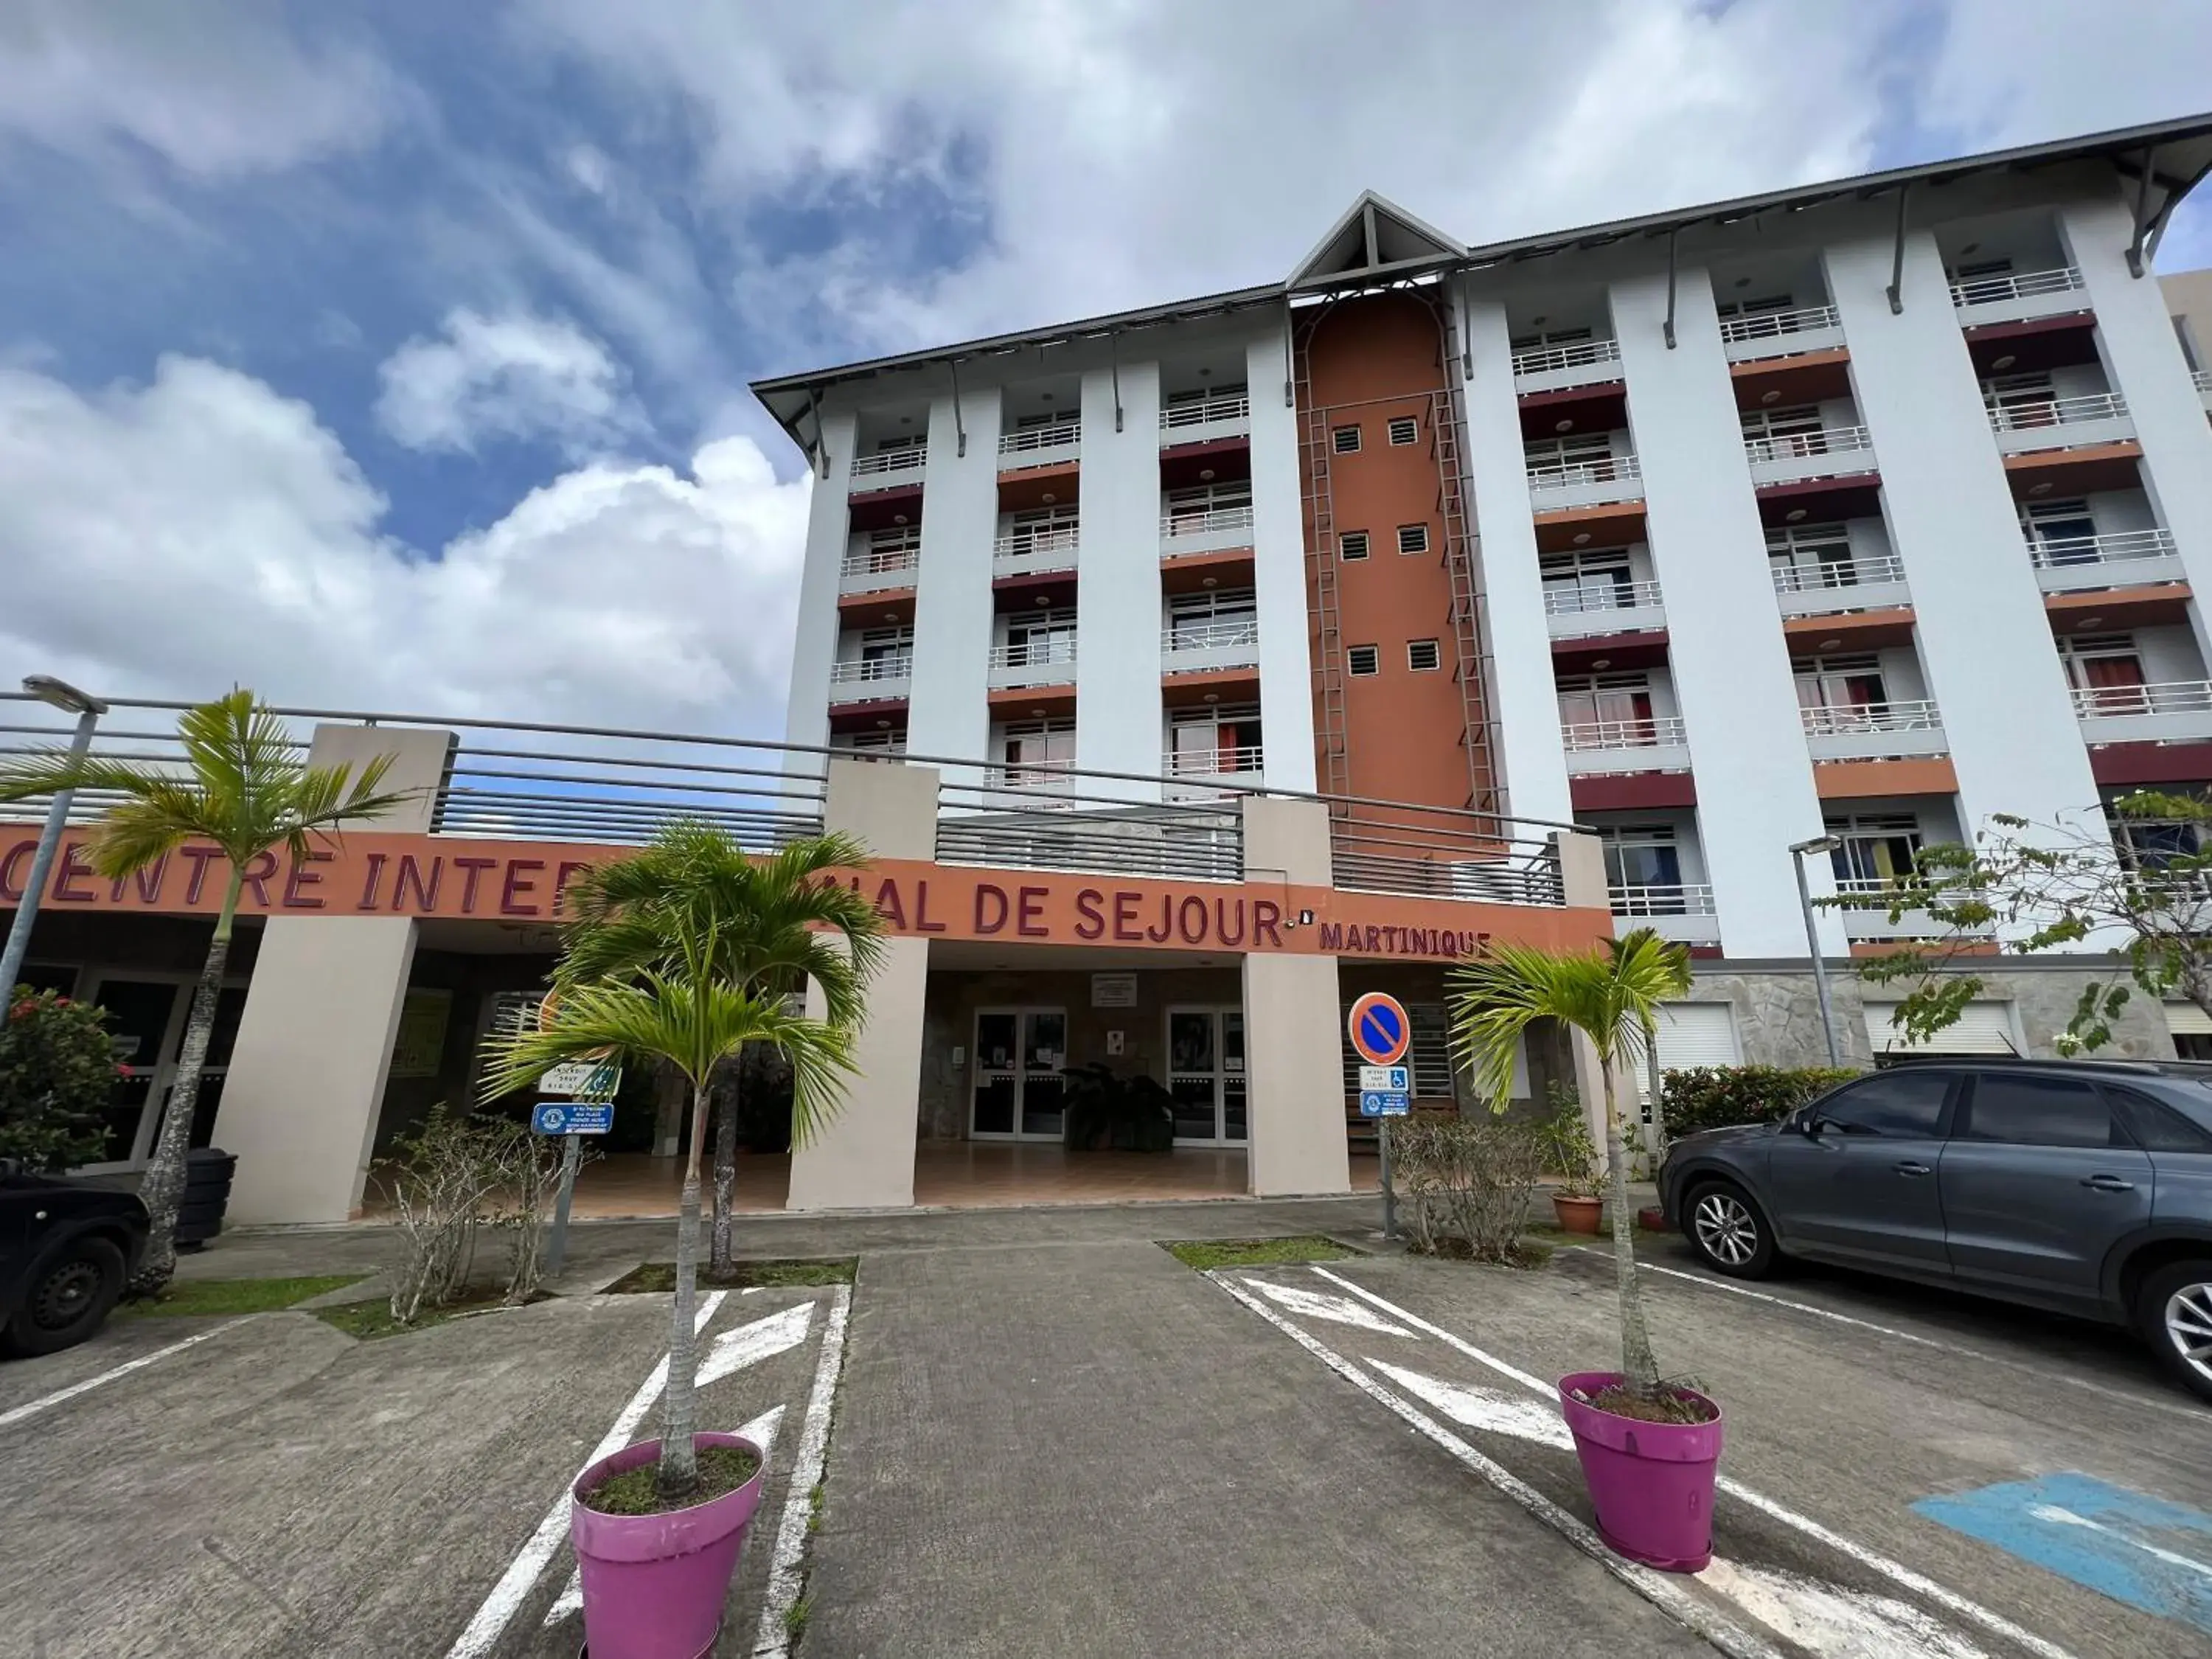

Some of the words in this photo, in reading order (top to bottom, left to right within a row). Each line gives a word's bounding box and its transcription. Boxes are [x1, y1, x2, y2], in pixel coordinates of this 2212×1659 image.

[0, 840, 338, 908] CENTRE
[974, 884, 1049, 936] DE
[1074, 888, 1283, 947] SEJOUR
[1318, 922, 1493, 959] MARTINIQUE
